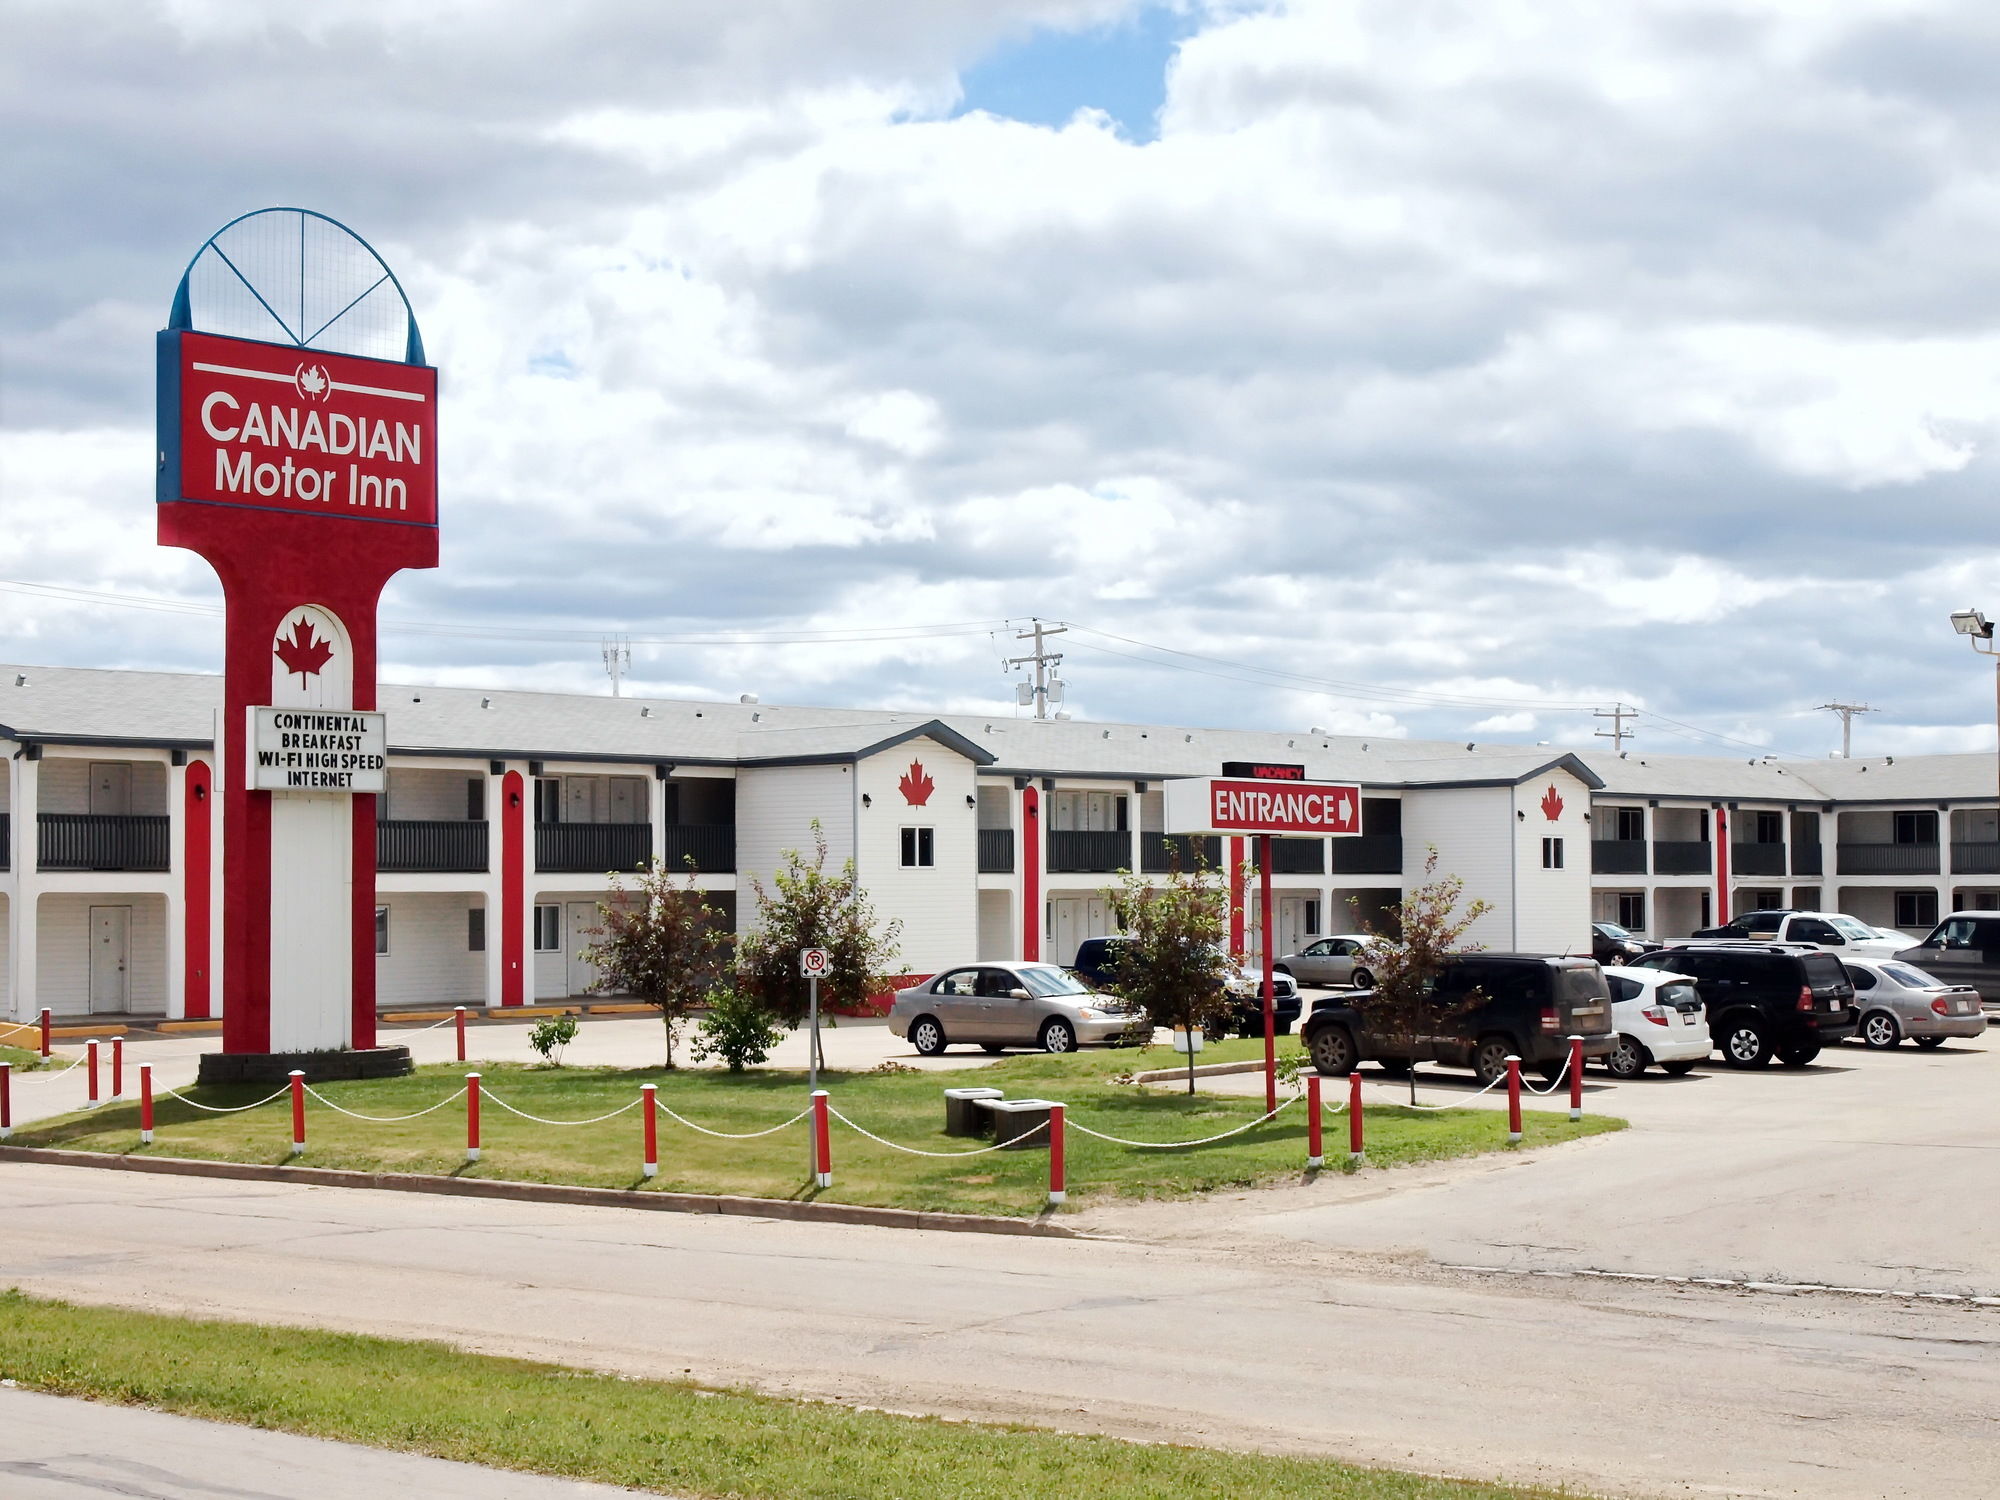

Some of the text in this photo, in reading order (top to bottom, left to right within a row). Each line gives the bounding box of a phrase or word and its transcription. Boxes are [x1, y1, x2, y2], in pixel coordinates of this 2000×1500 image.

[201, 391, 421, 465] CANADIAN
[215, 448, 407, 511] Motor Inn
[274, 713, 368, 733] CONTINENTAL
[281, 732, 362, 751] BREAKFAST
[258, 751, 384, 770] WI-FI HIGH SPEED
[287, 770, 353, 787] INTERNET
[1253, 766, 1303, 780] VACANCY
[1215, 790, 1335, 825] ENTRANCE
